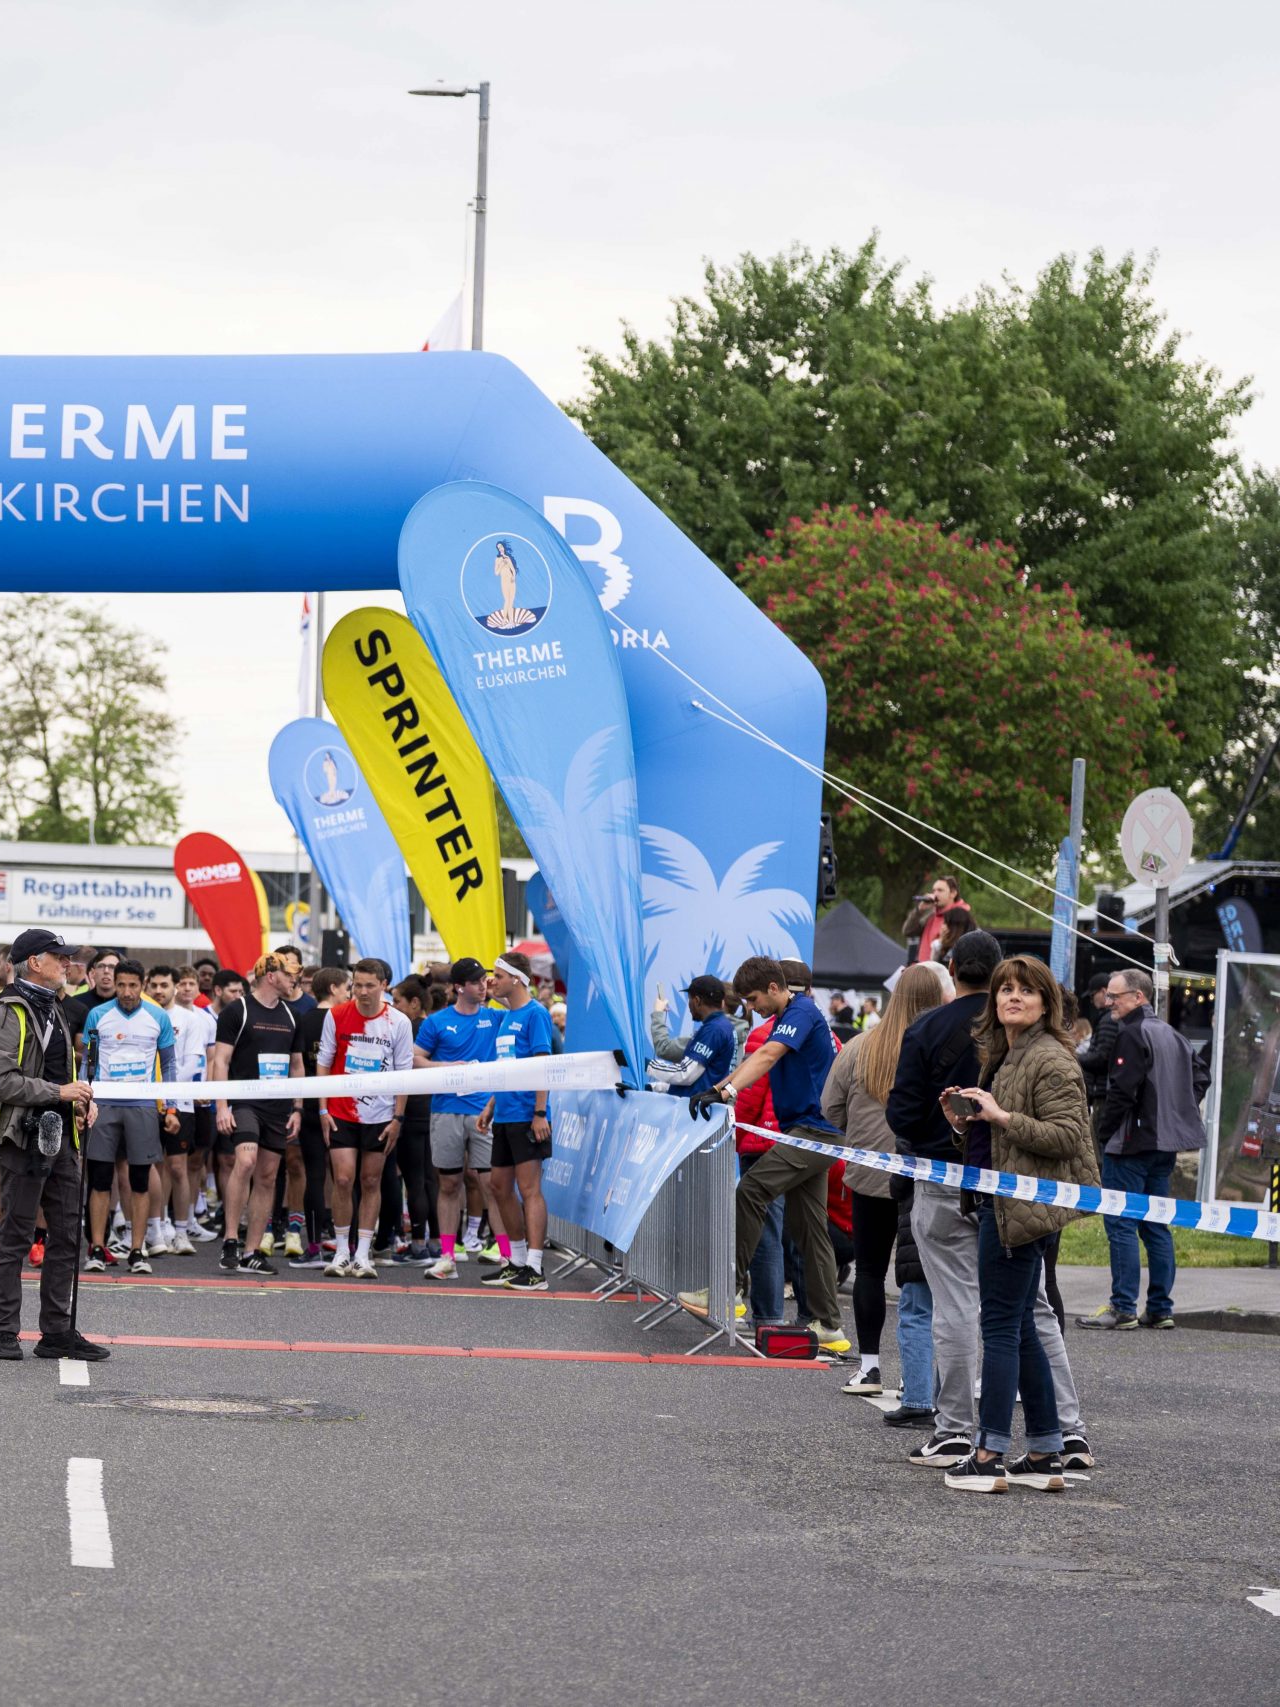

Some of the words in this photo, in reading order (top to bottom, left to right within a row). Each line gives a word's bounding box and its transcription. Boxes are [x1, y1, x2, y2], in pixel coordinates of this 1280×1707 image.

[473, 640, 564, 672] THERME
[476, 663, 568, 690] EUSKIRCHEN
[354, 628, 485, 903] SPRINTER
[312, 808, 366, 829] THERME
[23, 877, 174, 901] Regattabahn
[38, 903, 120, 921] Fühlinger
[125, 904, 157, 921] See
[693, 1042, 713, 1059] TEAM
